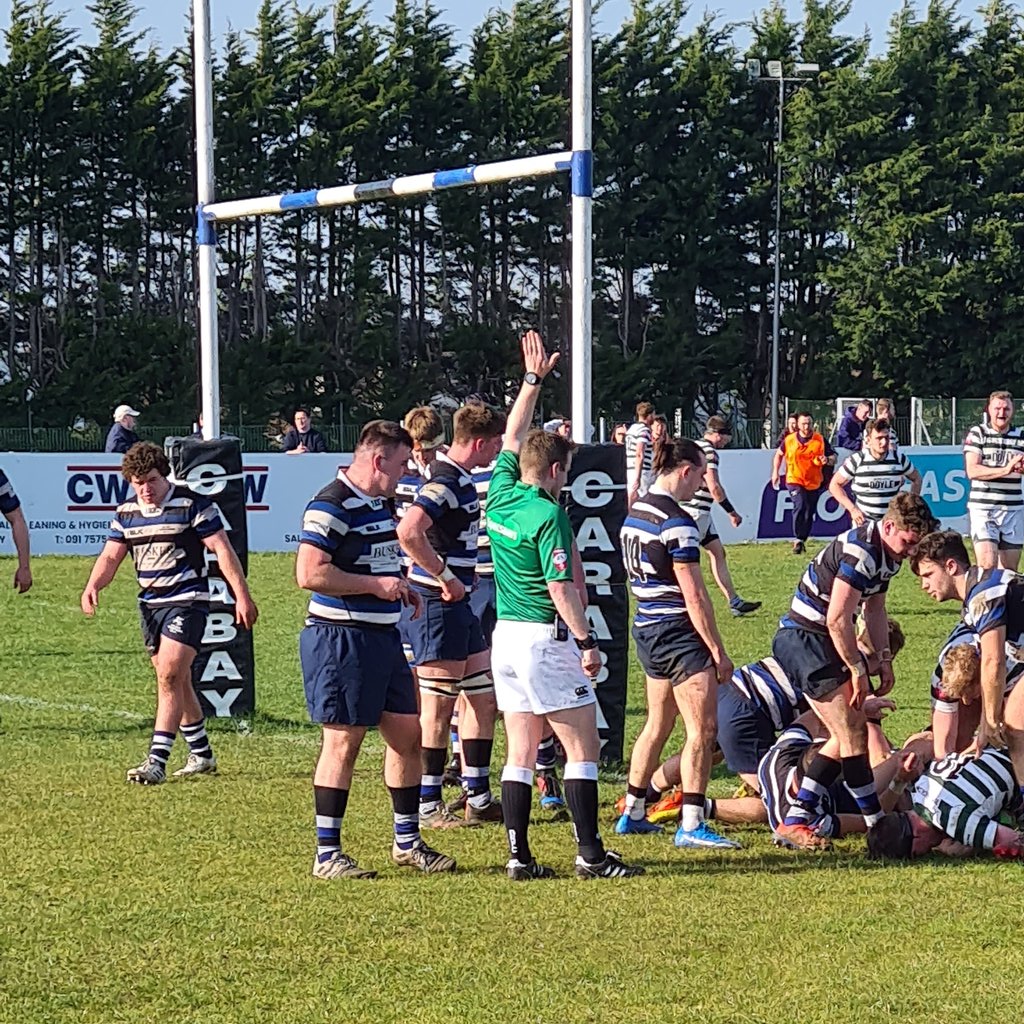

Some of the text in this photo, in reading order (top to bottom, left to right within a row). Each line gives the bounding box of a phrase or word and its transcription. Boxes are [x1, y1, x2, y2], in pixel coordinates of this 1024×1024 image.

[66, 473, 131, 504] CW
[29, 520, 67, 530] EANING
[68, 520, 76, 530] &
[78, 520, 112, 530] HYGIE
[65, 535, 81, 544] 091
[84, 534, 107, 544] 7575
